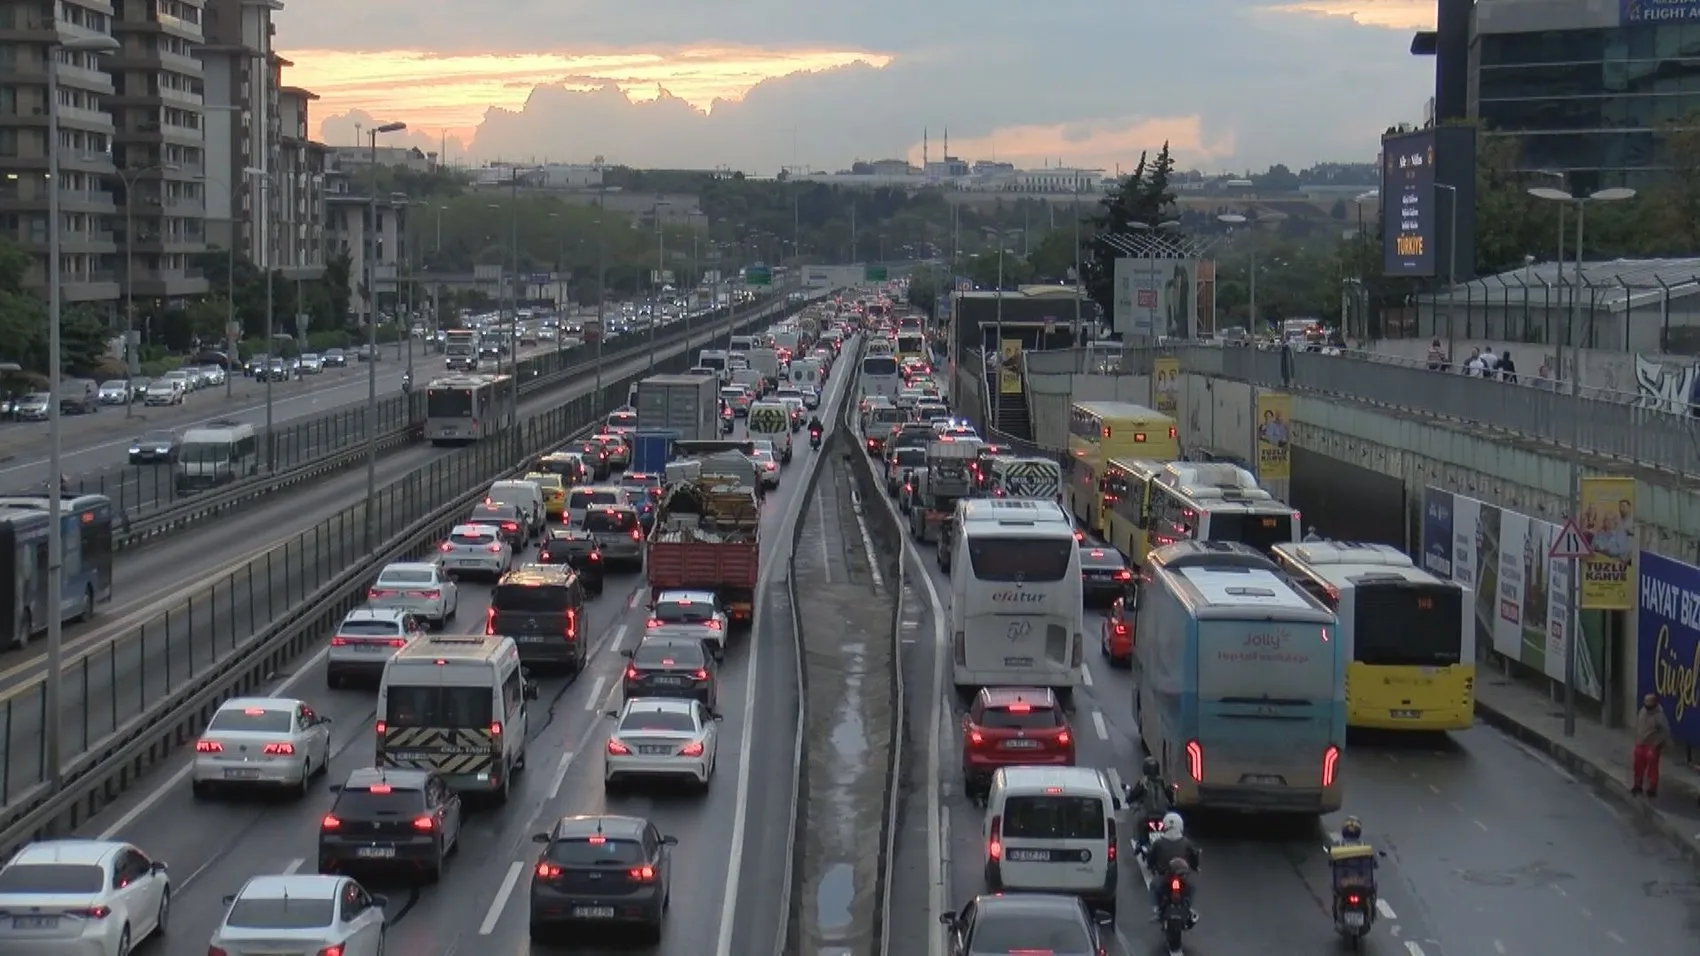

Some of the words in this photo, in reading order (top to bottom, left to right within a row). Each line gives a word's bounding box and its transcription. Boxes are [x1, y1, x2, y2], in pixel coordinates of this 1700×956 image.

[1643, 7, 1686, 20] FLIGHT
[1396, 233, 1424, 256] TÜRKİYE
[1585, 571, 1627, 581] KAHVE
[1586, 561, 1627, 572] TUZLU
[1641, 574, 1680, 620] HAYAT
[1243, 631, 1281, 650] Jolly
[1655, 623, 1700, 723] Güzel
